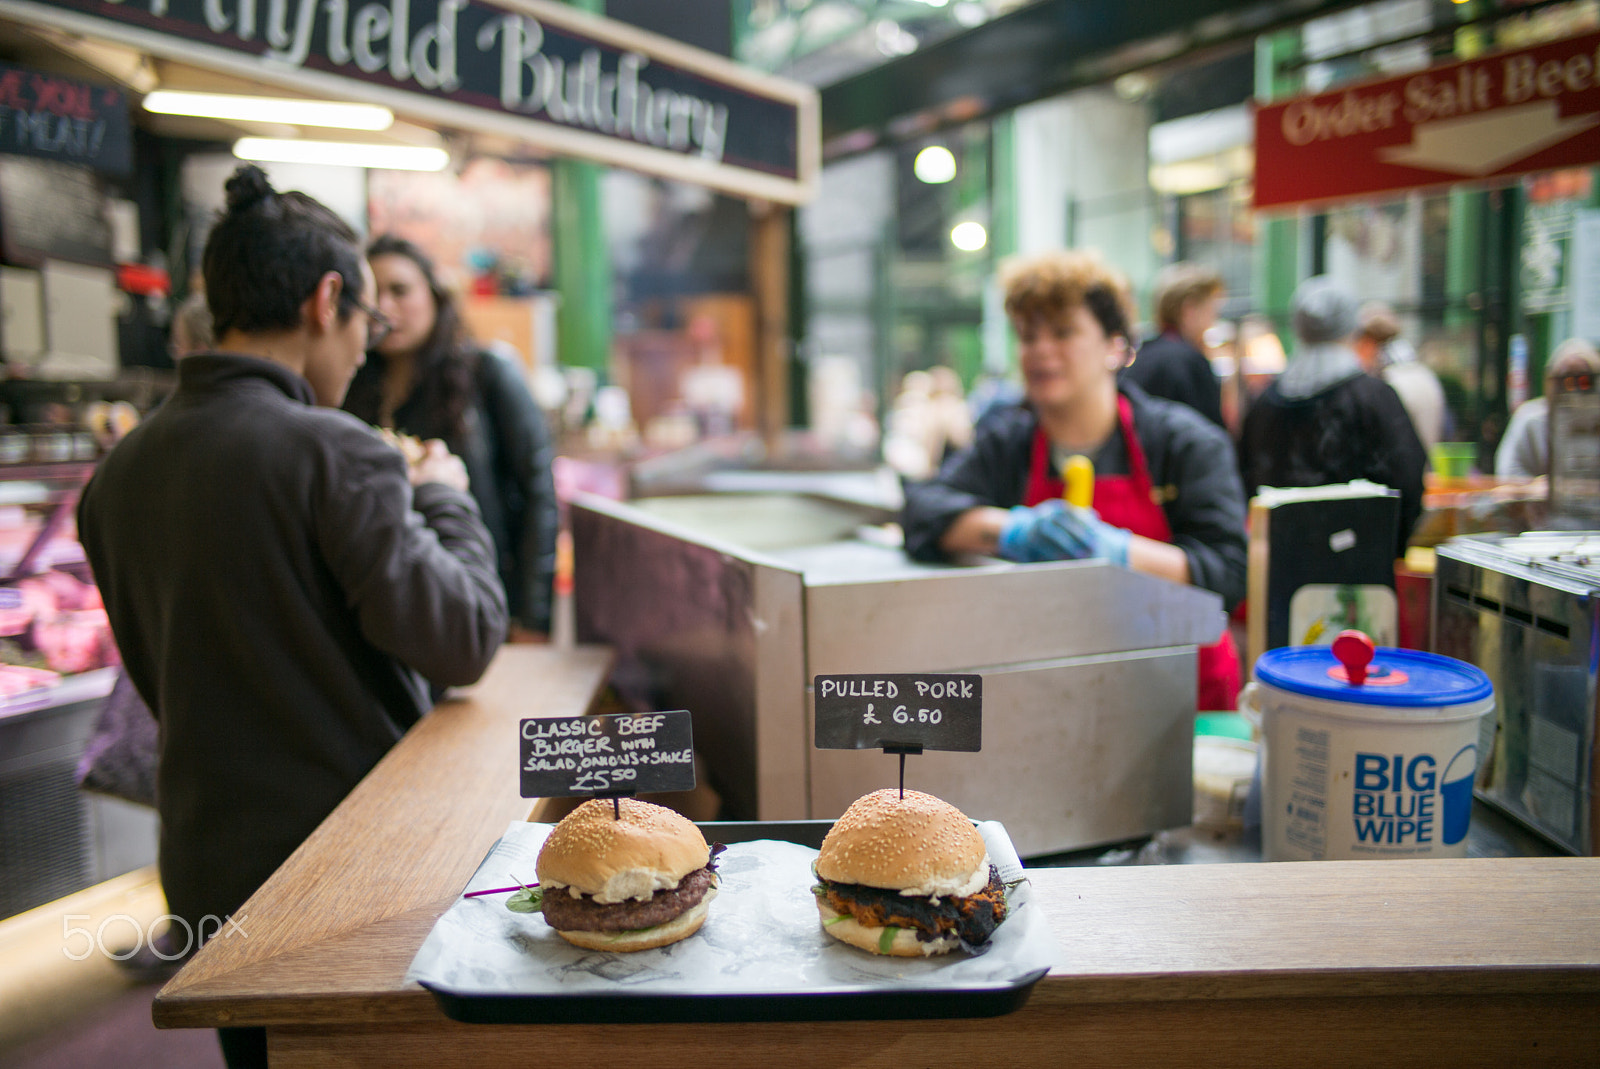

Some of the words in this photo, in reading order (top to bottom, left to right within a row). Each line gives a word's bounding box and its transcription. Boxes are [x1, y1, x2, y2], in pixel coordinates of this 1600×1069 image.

[477, 14, 729, 163] Butchery
[1281, 90, 1395, 146] Order
[1402, 63, 1492, 123] Salt
[821, 679, 899, 699] PULLED
[914, 679, 974, 699] PORK
[522, 719, 602, 740] CLASSIC
[614, 714, 666, 736] BEEF
[892, 704, 943, 725] 6.50
[531, 736, 614, 758] BURGER
[621, 737, 656, 751] WITH
[1354, 752, 1437, 793] BIG
[1353, 793, 1435, 818] BLUE
[1353, 818, 1433, 844] WIPE
